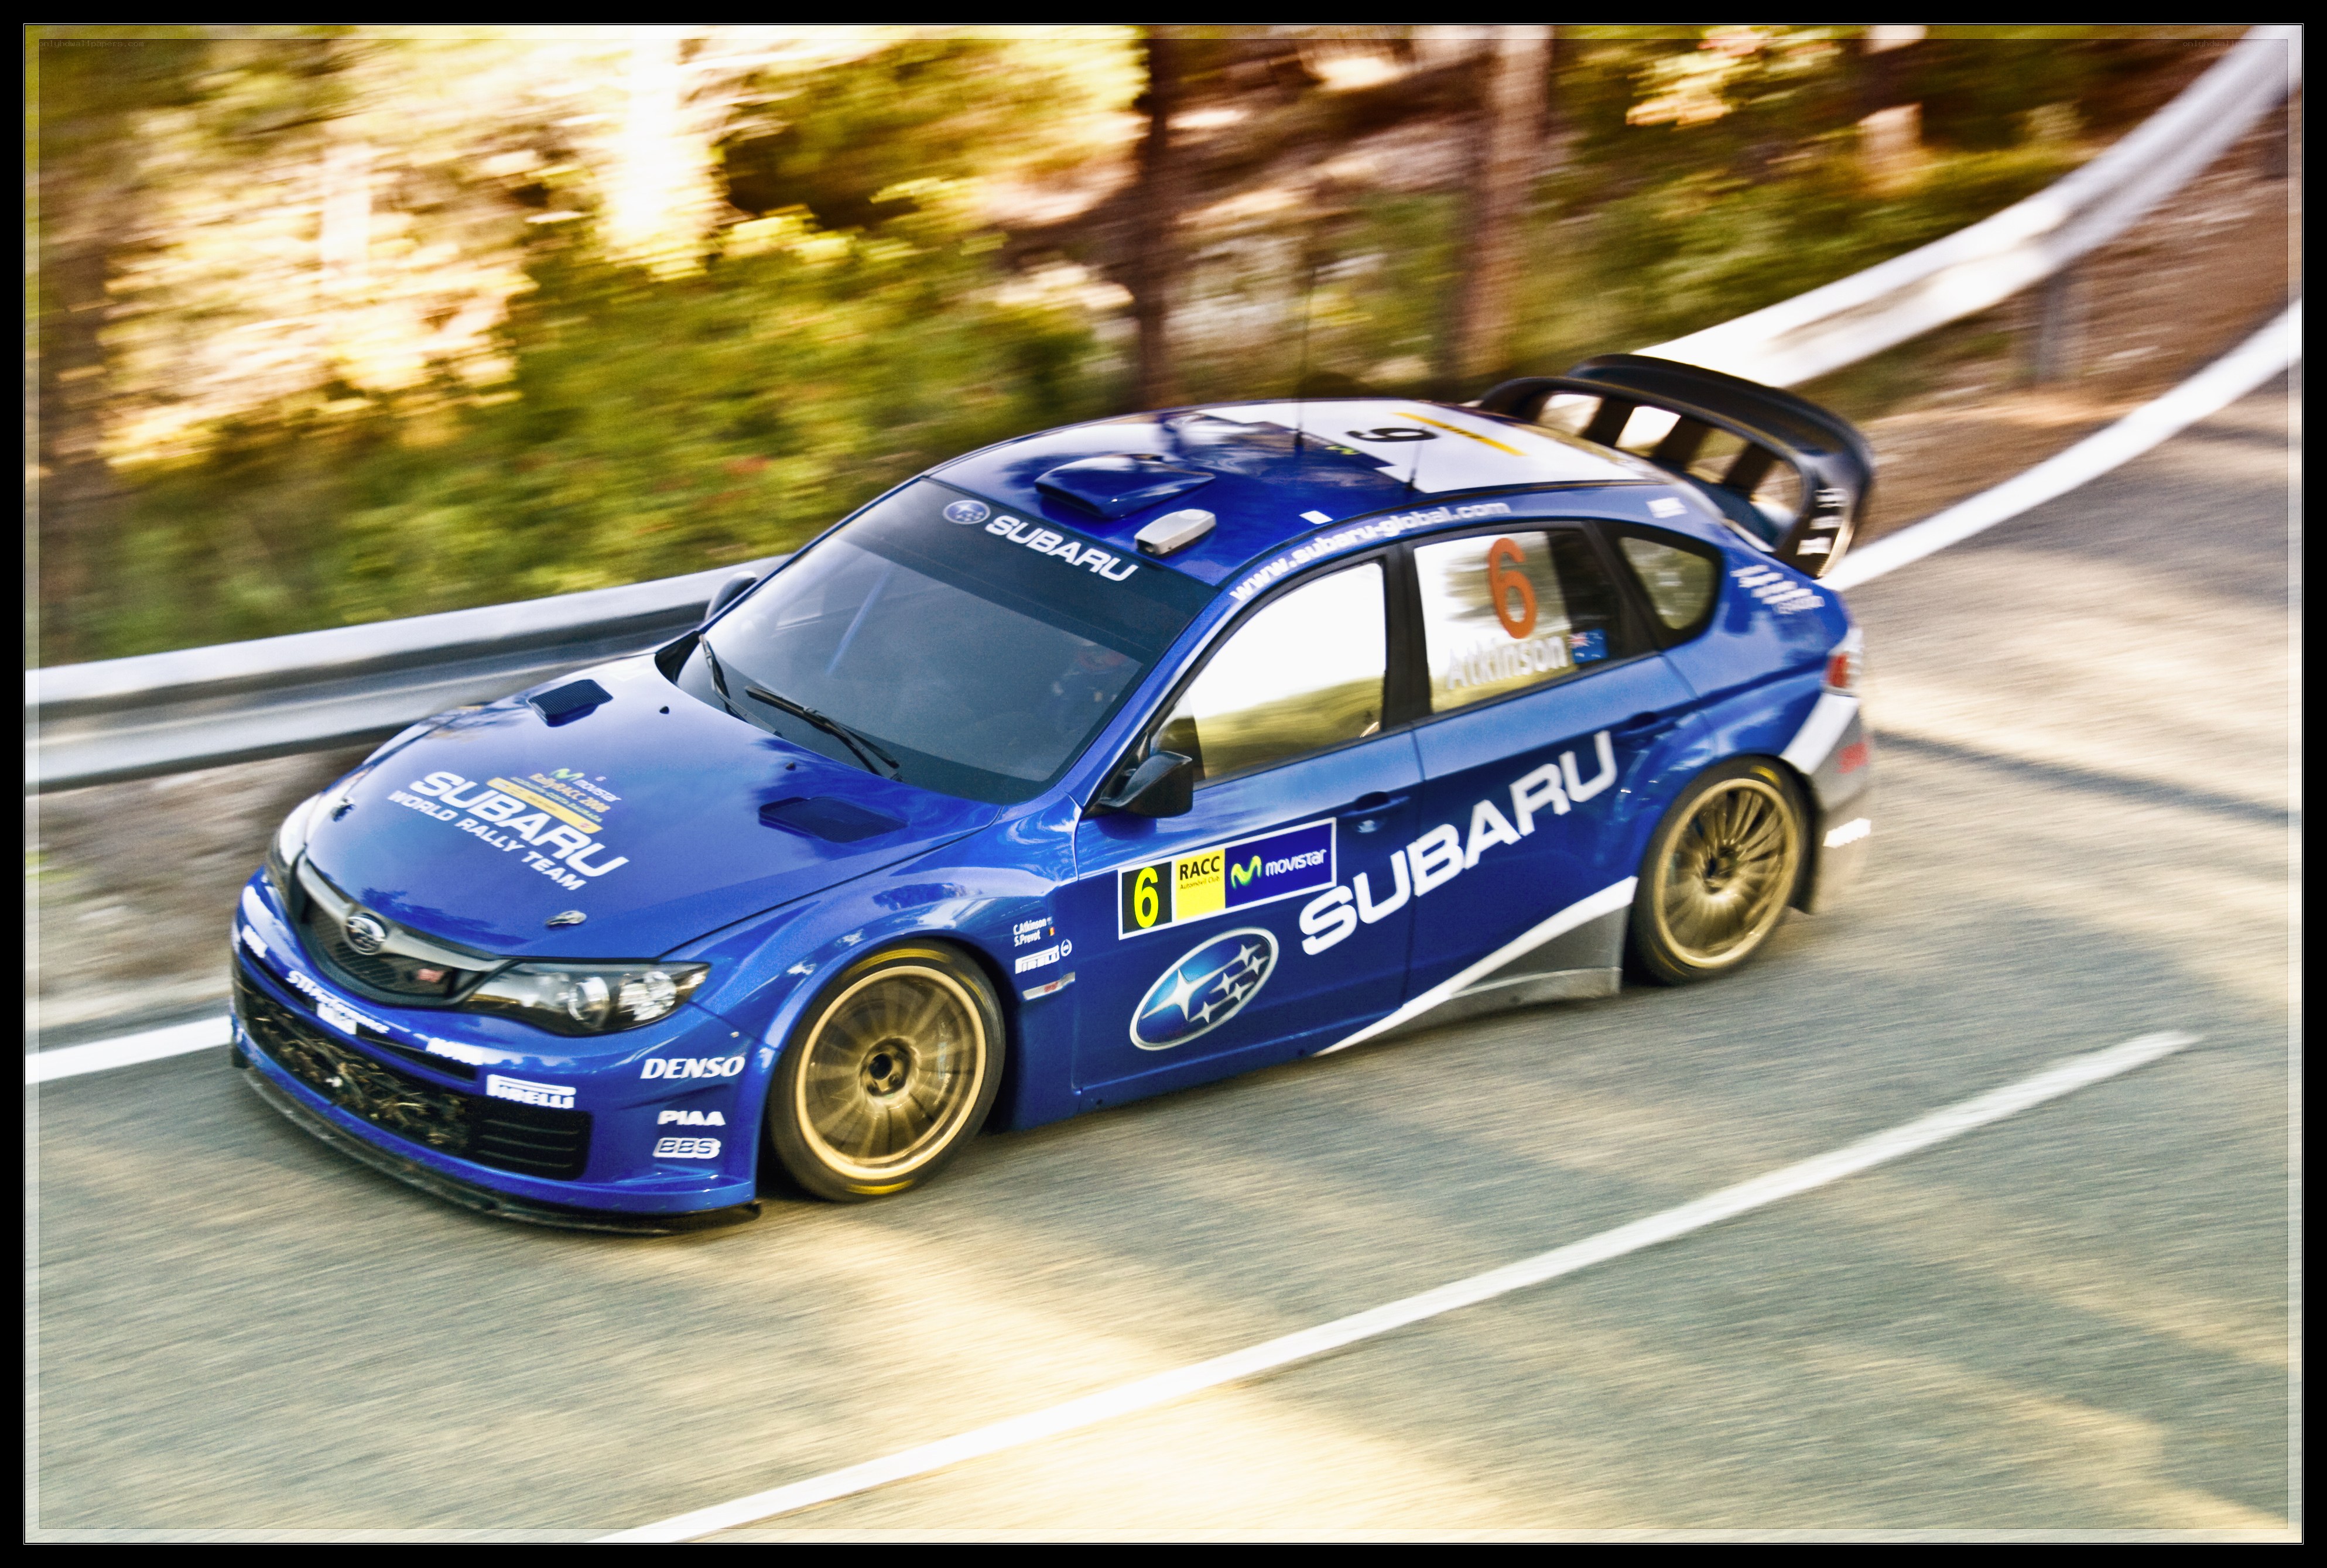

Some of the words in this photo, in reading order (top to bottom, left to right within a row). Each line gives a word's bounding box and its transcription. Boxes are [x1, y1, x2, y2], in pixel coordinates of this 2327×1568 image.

[985, 515, 1138, 581] SUBARU
[1230, 502, 1512, 601] www.subaru-global.com
[1488, 537, 1538, 639] 6
[1446, 635, 1568, 690] Atkinson
[387, 790, 458, 821] WORLD
[454, 817, 527, 852] RALLY
[521, 850, 587, 891] TEAM
[409, 771, 630, 877] SUBARU
[1299, 730, 1617, 956] SUBARU
[1179, 855, 1220, 881] RACC
[1265, 849, 1327, 877] movistar
[1134, 867, 1159, 929] 6
[486, 1074, 576, 1109] PIRELLI
[640, 1056, 745, 1079] DENSO
[657, 1110, 726, 1126] PIAA
